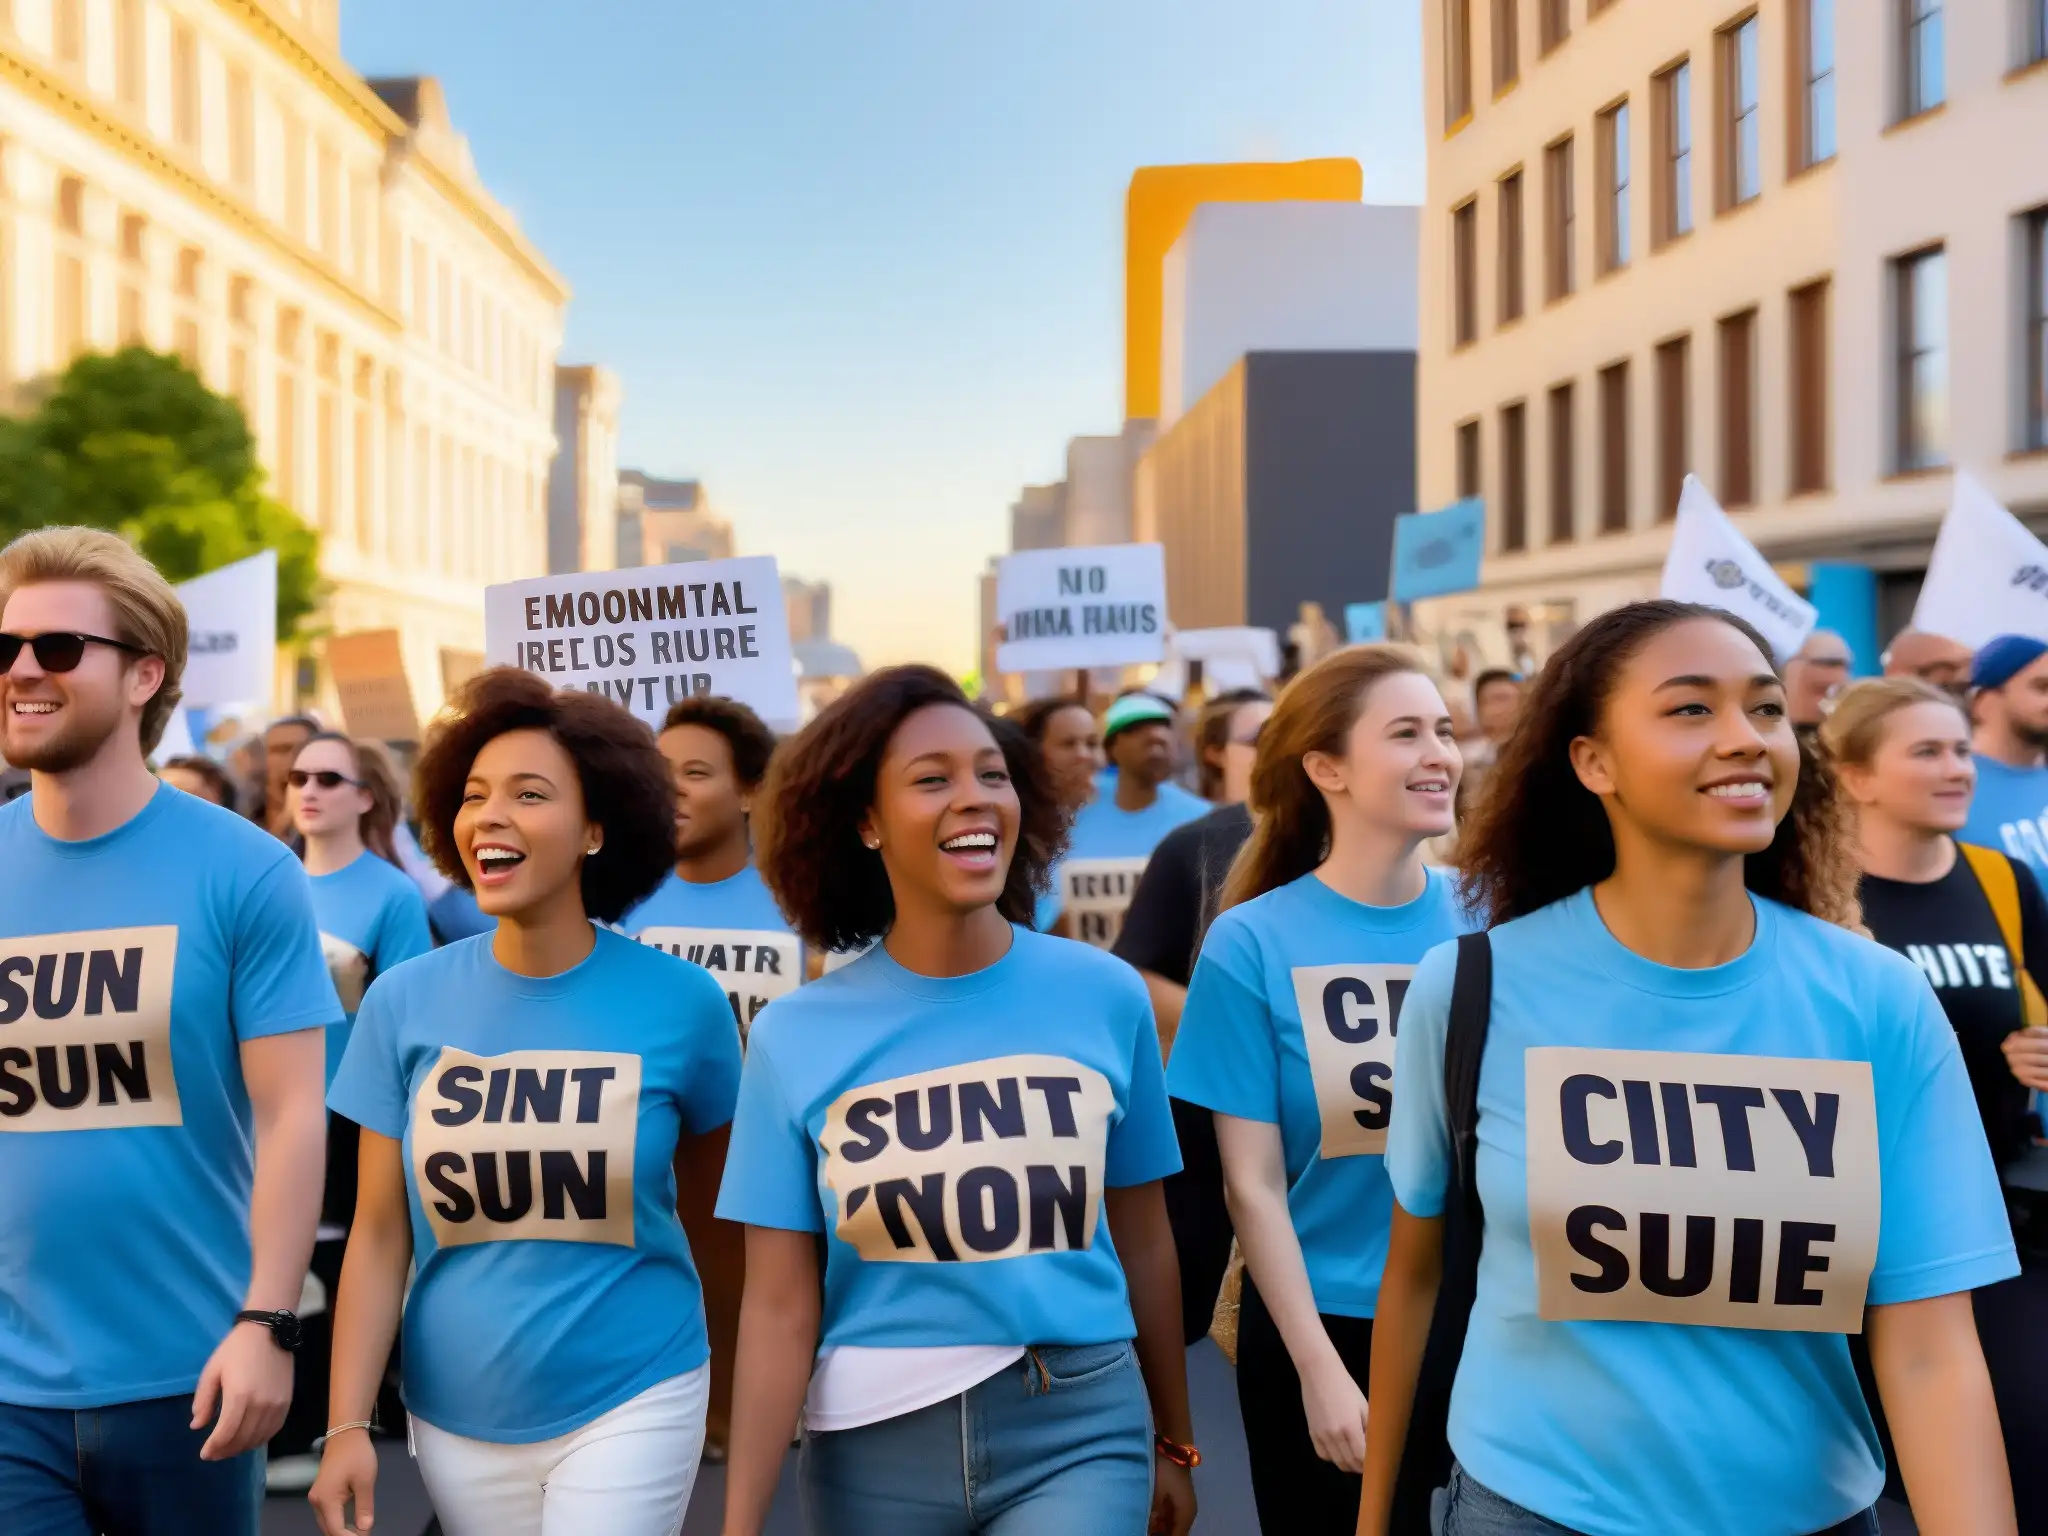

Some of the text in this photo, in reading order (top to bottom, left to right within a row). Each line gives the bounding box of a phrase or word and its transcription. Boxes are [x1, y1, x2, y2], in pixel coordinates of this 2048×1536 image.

[525, 581, 758, 631] EMOONMTAL
[1058, 565, 1107, 595] NO
[651, 624, 760, 666] RIURE
[0, 947, 143, 1025] SUN
[0, 1040, 152, 1118] SUN
[430, 1065, 615, 1127] SINT
[840, 1076, 1082, 1164] SUNT
[1560, 1073, 1840, 1178] CIITY
[424, 1149, 607, 1223] SUN
[1565, 1204, 1837, 1306] SUIE
